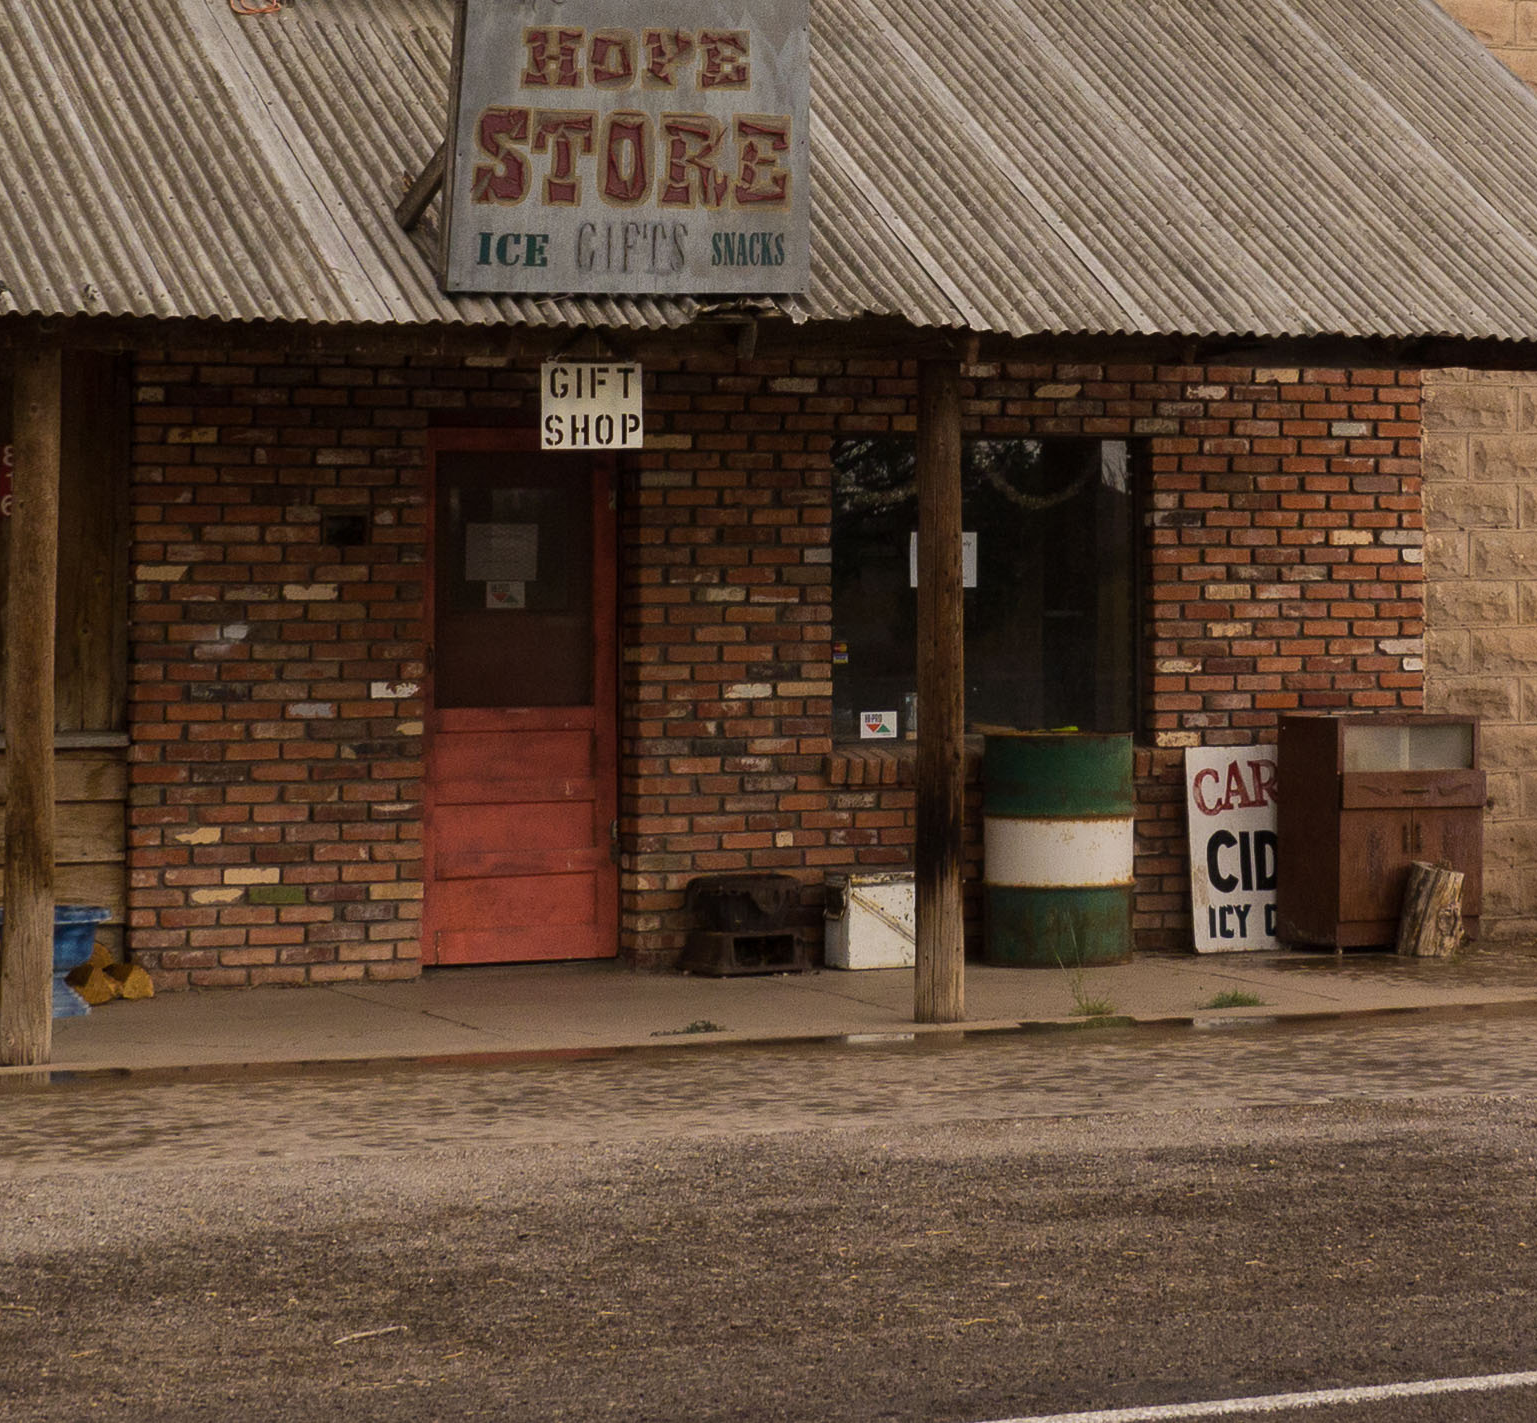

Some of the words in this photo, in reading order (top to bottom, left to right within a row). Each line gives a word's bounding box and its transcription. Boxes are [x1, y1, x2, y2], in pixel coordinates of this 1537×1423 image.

[520, 26, 752, 91] HOPE
[471, 105, 793, 212] STORE
[476, 232, 549, 267] ICE
[575, 222, 690, 274] GIFTS
[711, 231, 786, 266] SNACKS
[549, 367, 636, 399] GIFT
[545, 414, 640, 446] SHOP
[1208, 904, 1253, 939] ICY
